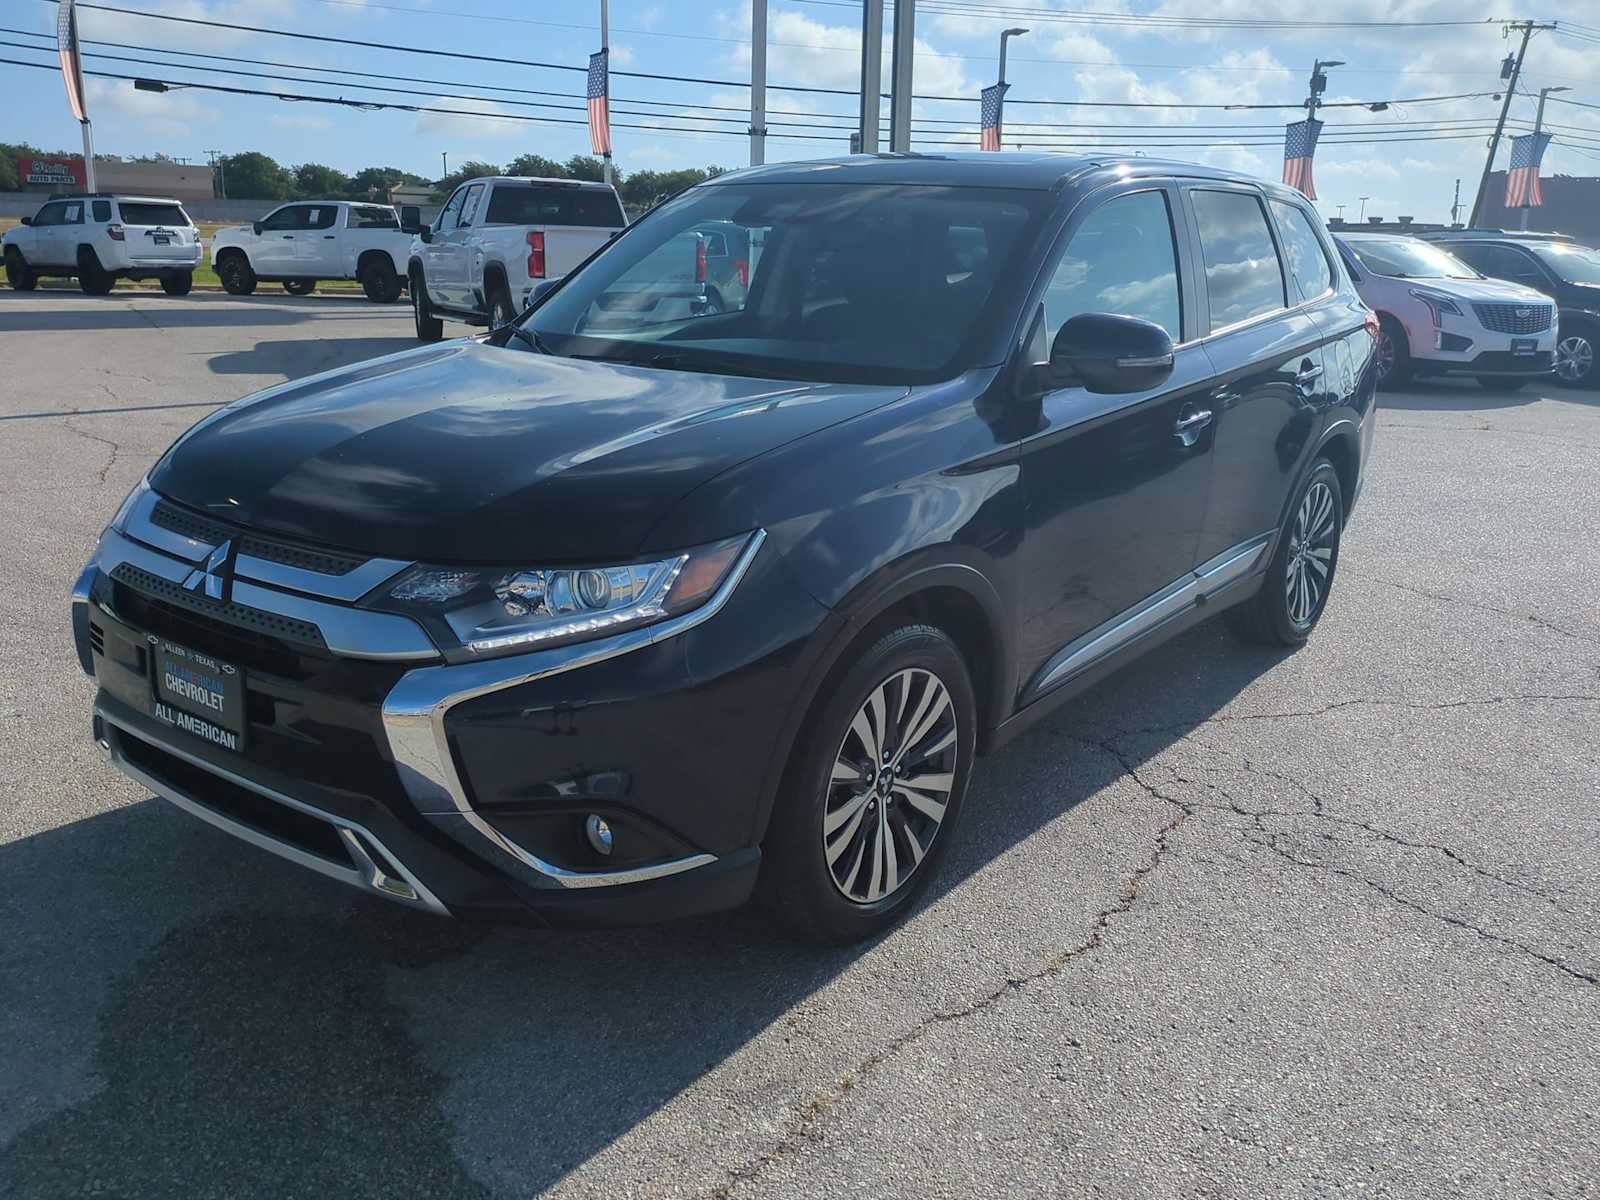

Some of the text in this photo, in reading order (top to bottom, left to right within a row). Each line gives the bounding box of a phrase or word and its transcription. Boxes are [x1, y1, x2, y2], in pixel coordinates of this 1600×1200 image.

[195, 654, 215, 669] TEXAS
[165, 673, 224, 712] CHEVROLET
[155, 703, 236, 750] ALL AMERICAN
